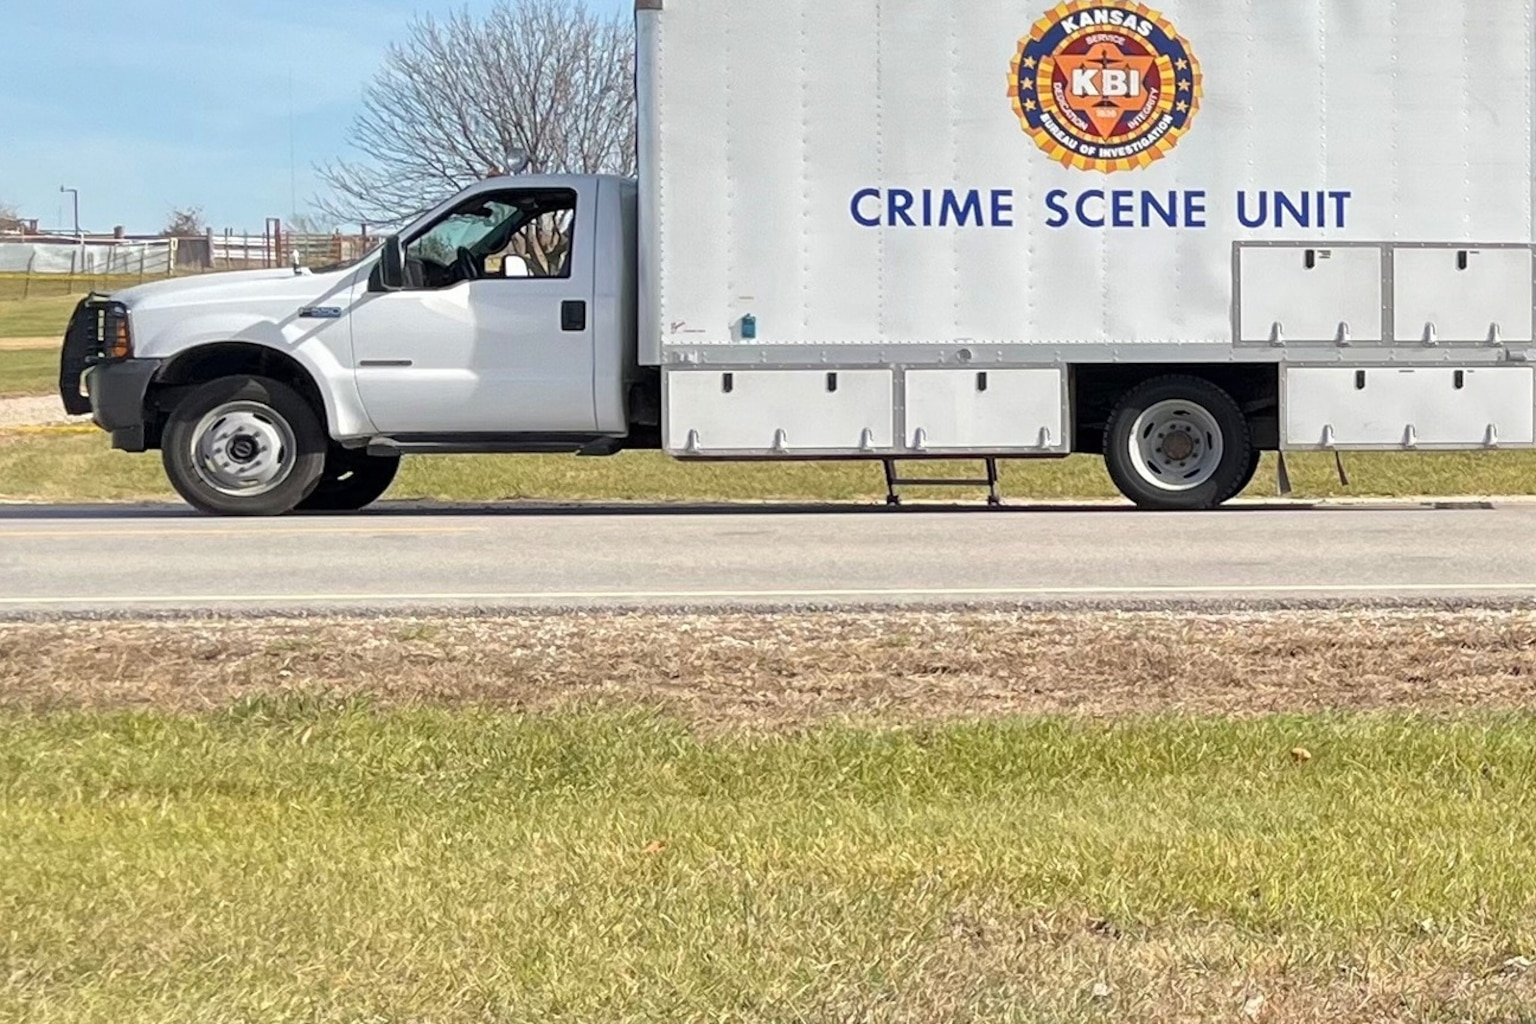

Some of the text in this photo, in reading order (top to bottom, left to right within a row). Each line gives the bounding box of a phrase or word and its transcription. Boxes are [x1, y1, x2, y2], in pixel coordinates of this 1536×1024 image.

[1060, 8, 1153, 36] KANSAS
[1085, 34, 1126, 46] SERVICE
[1072, 68, 1139, 96] KBI
[1053, 82, 1089, 131] DEDICATION
[1127, 87, 1160, 129] INTEGRITY
[1040, 113, 1173, 158] BUREAU OF INVESTIGATION
[850, 188, 1352, 229] CRIME SCENE UNIT
